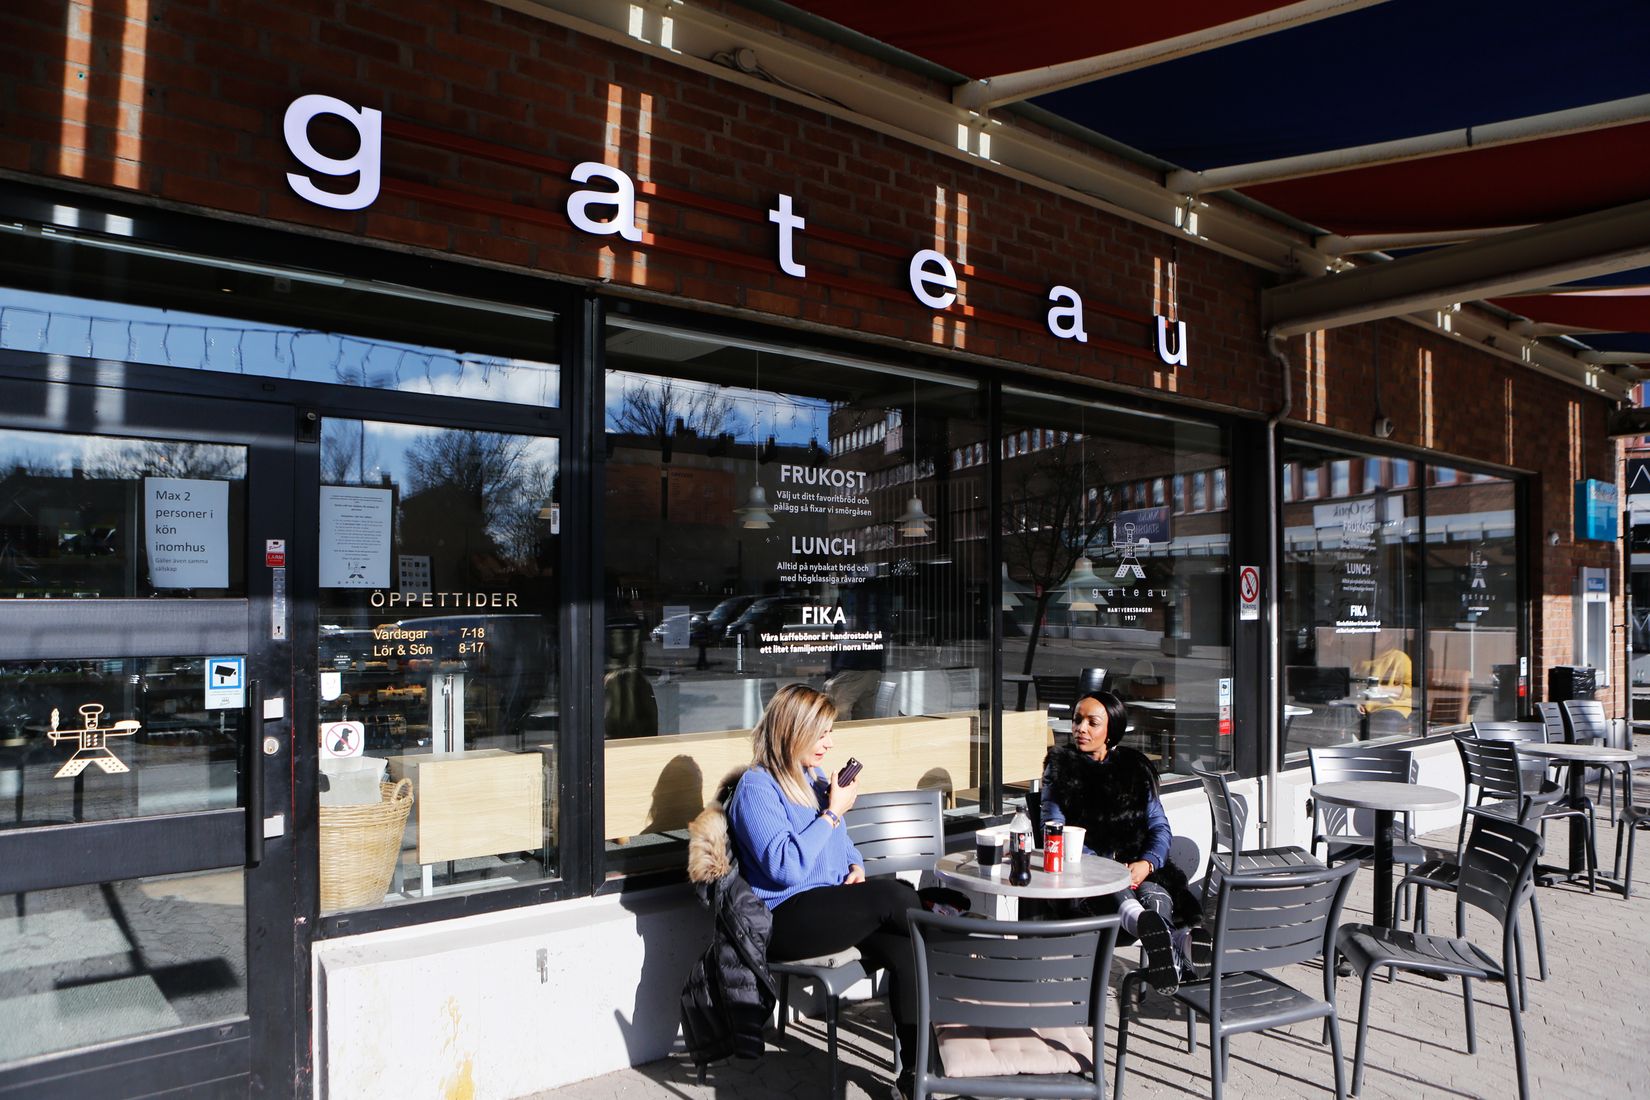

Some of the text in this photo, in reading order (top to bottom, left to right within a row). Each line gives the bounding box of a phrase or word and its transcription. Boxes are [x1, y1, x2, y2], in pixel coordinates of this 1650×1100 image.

[283, 94, 1188, 367] gateau
[781, 465, 867, 489] FRUKOST
[156, 490, 191, 501] Max 2
[777, 491, 870, 505] Välj ut ditt favoritbröd och
[155, 509, 207, 519] personer
[774, 503, 872, 517] pålägg så fixar vi smörgåsen
[155, 524, 177, 535] kön
[155, 541, 206, 553] inomhus
[791, 536, 856, 556] LUNCH
[777, 562, 869, 573] Alltid på nybakat bröd och
[1346, 563, 1371, 575] LUNCH
[780, 574, 866, 585] med högklassiga råvaror
[371, 589, 519, 608] ÖPPETTIDER
[1092, 588, 1168, 599] gateau
[802, 606, 847, 625] FIKA
[1350, 605, 1368, 617] FIKA
[373, 627, 485, 642] Vardagar 7-18
[760, 631, 883, 642] Våra kaffebönor är handrostade på
[374, 642, 485, 657] Lör & Sön 8-17
[760, 646, 772, 654] ett
[772, 645, 789, 654] litet
[842, 644, 862, 652] norra
